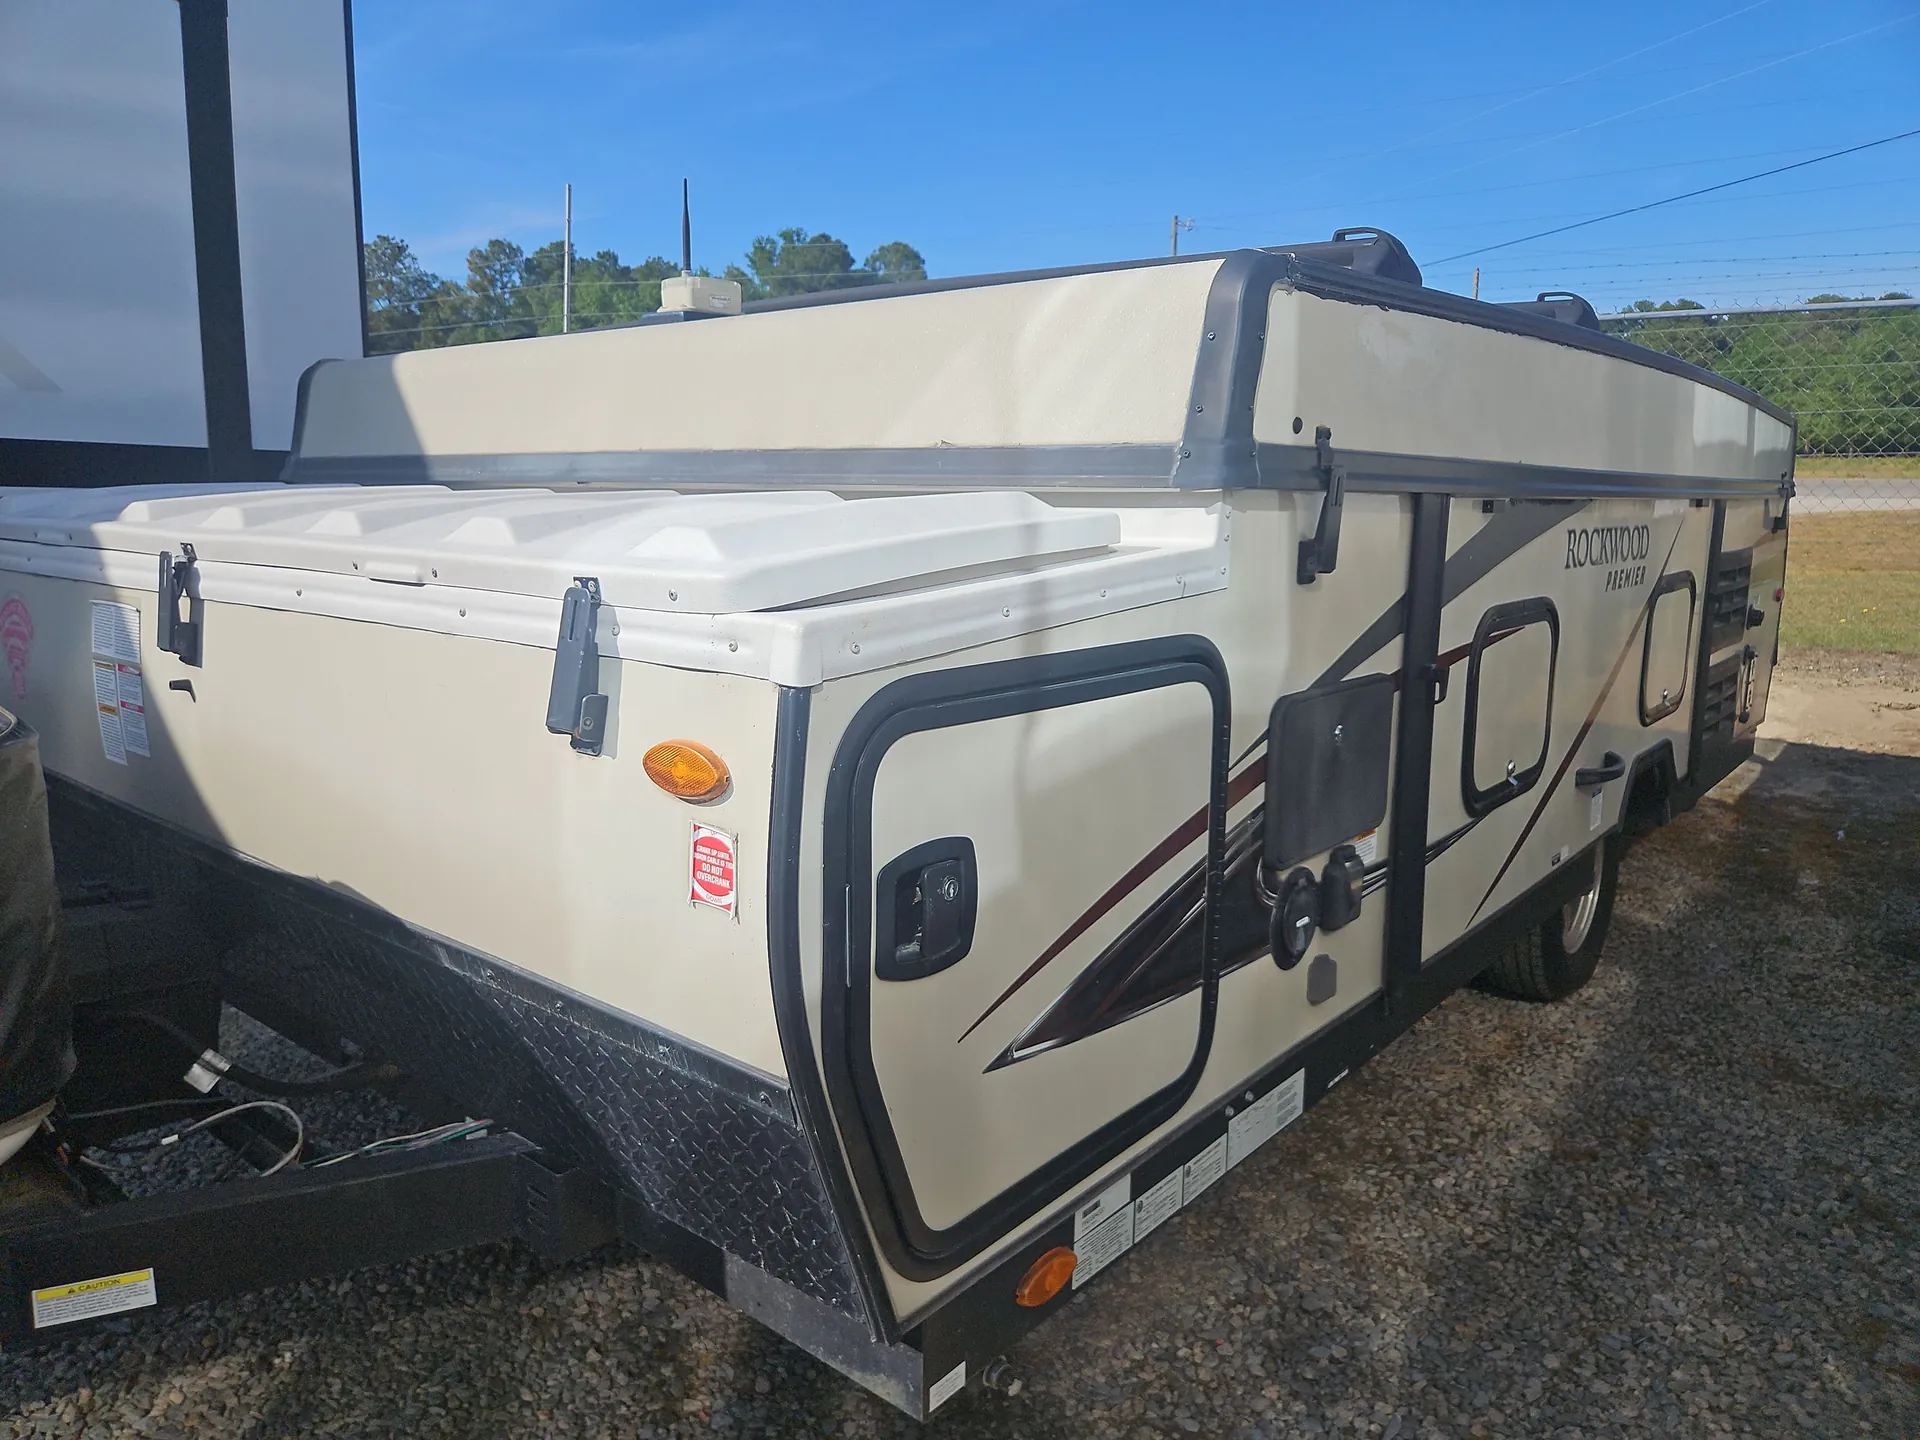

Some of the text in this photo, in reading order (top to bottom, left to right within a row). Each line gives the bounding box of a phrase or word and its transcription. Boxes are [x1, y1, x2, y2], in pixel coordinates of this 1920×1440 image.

[1565, 524, 1650, 569] ROCKWOOD
[1605, 565, 1646, 592] PREMIER
[711, 848, 718, 856] UP
[707, 855, 720, 866] CABLE
[702, 862, 723, 876] DO NOT
[697, 870, 731, 888] OVERCRANK
[705, 893, 723, 904] DOWN
[78, 1279, 121, 1291] CAUTION
